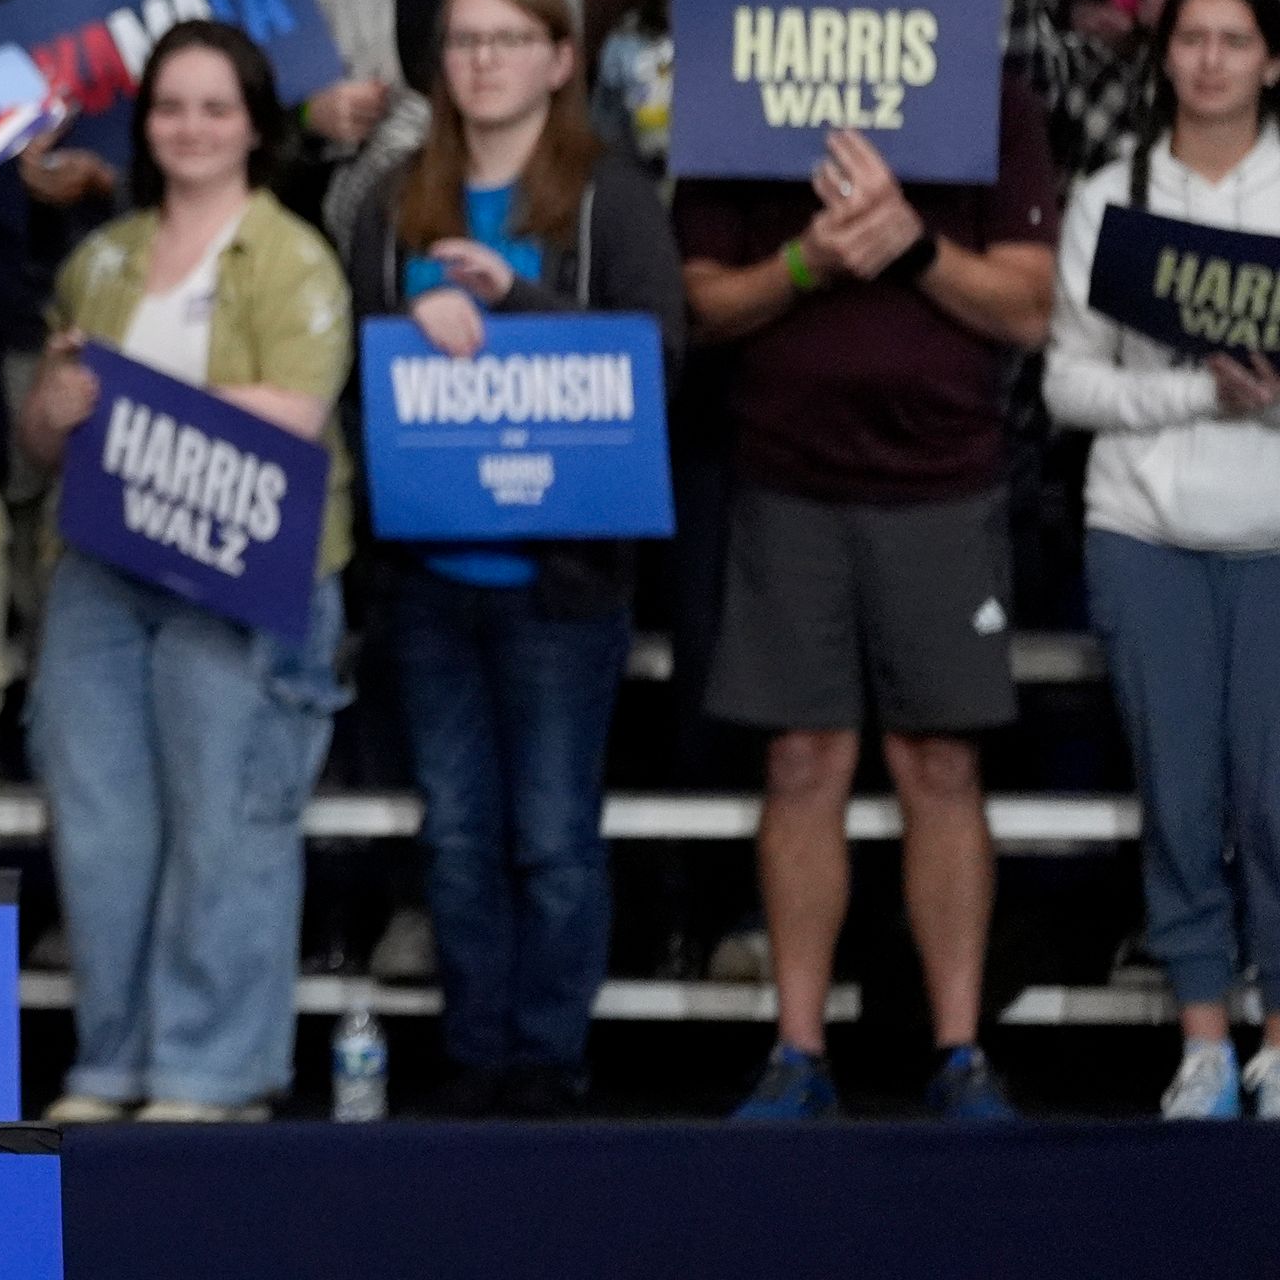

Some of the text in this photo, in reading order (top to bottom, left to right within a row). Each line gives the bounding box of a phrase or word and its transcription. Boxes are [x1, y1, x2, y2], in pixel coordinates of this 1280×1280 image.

[733, 6, 939, 87] HARRIS
[762, 82, 904, 130] WALZ
[392, 352, 635, 424] WISCONSIN
[102, 396, 287, 542] HARRIS
[121, 487, 249, 577] WALZ
